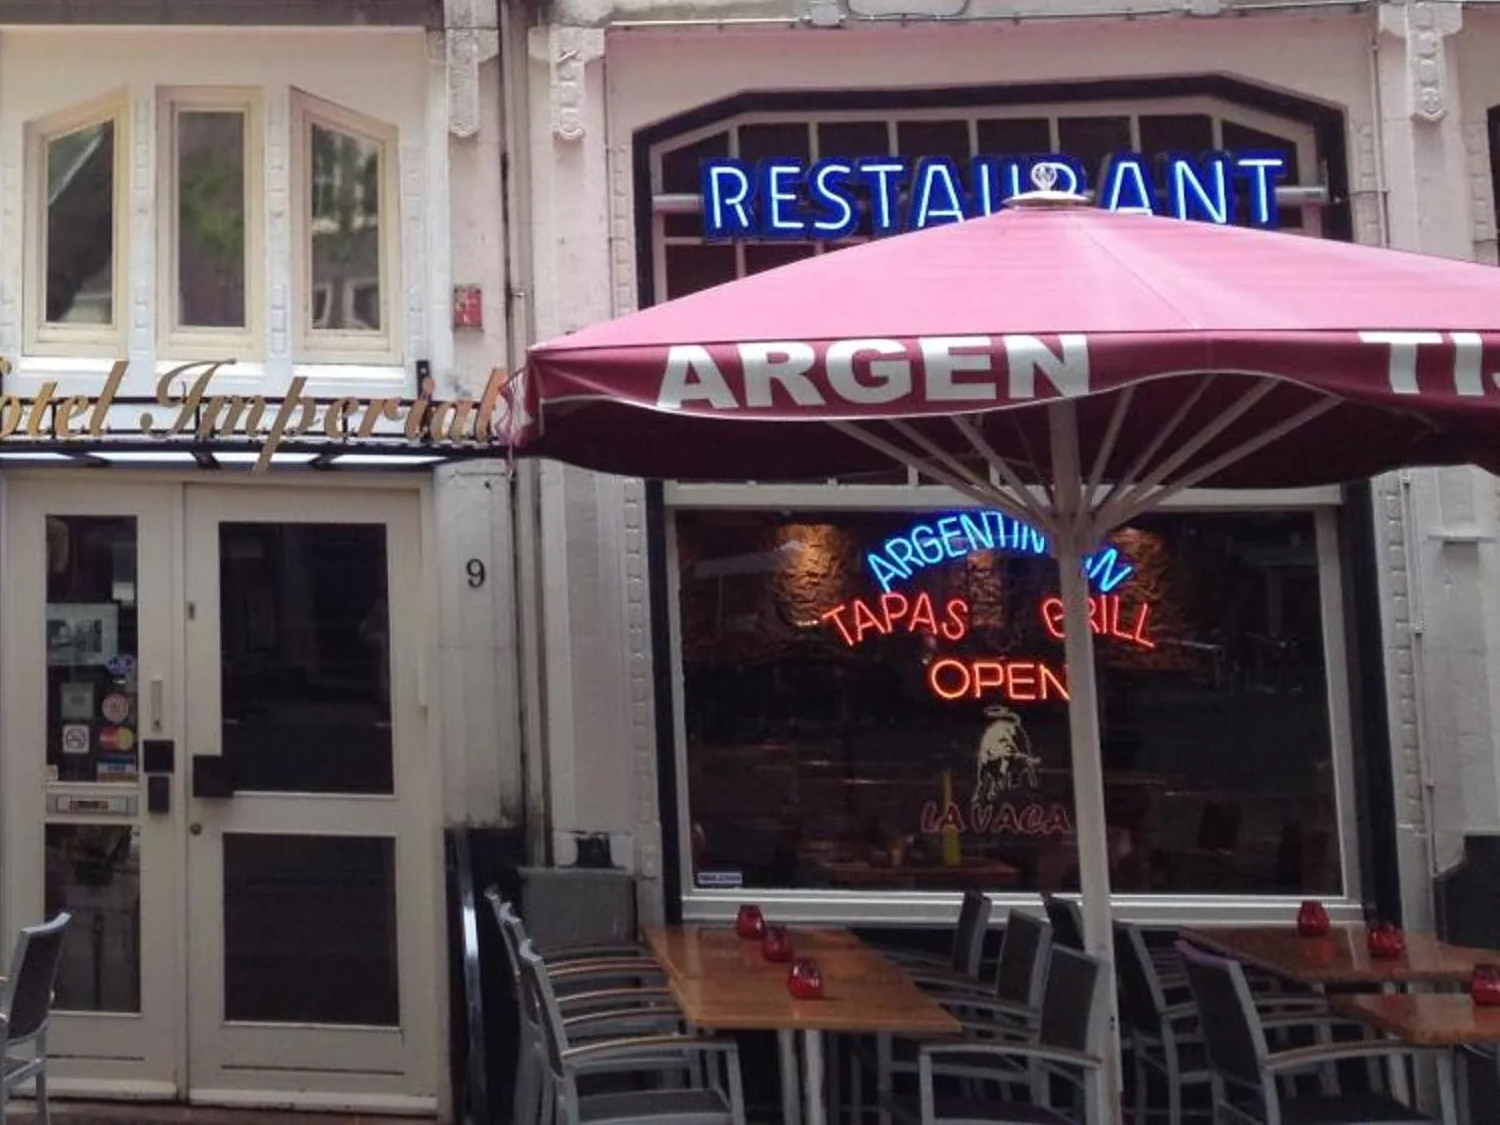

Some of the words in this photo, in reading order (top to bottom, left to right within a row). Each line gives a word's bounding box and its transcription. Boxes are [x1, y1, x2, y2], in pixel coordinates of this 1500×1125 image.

[656, 333, 1091, 411] ARGEN
[1357, 331, 1500, 396] TI
[139, 358, 509, 475] Imperial
[466, 558, 486, 589] 9
[866, 510, 1133, 594] ARGENTINN
[822, 591, 969, 648] TAPAS
[930, 659, 1070, 702] OPEN
